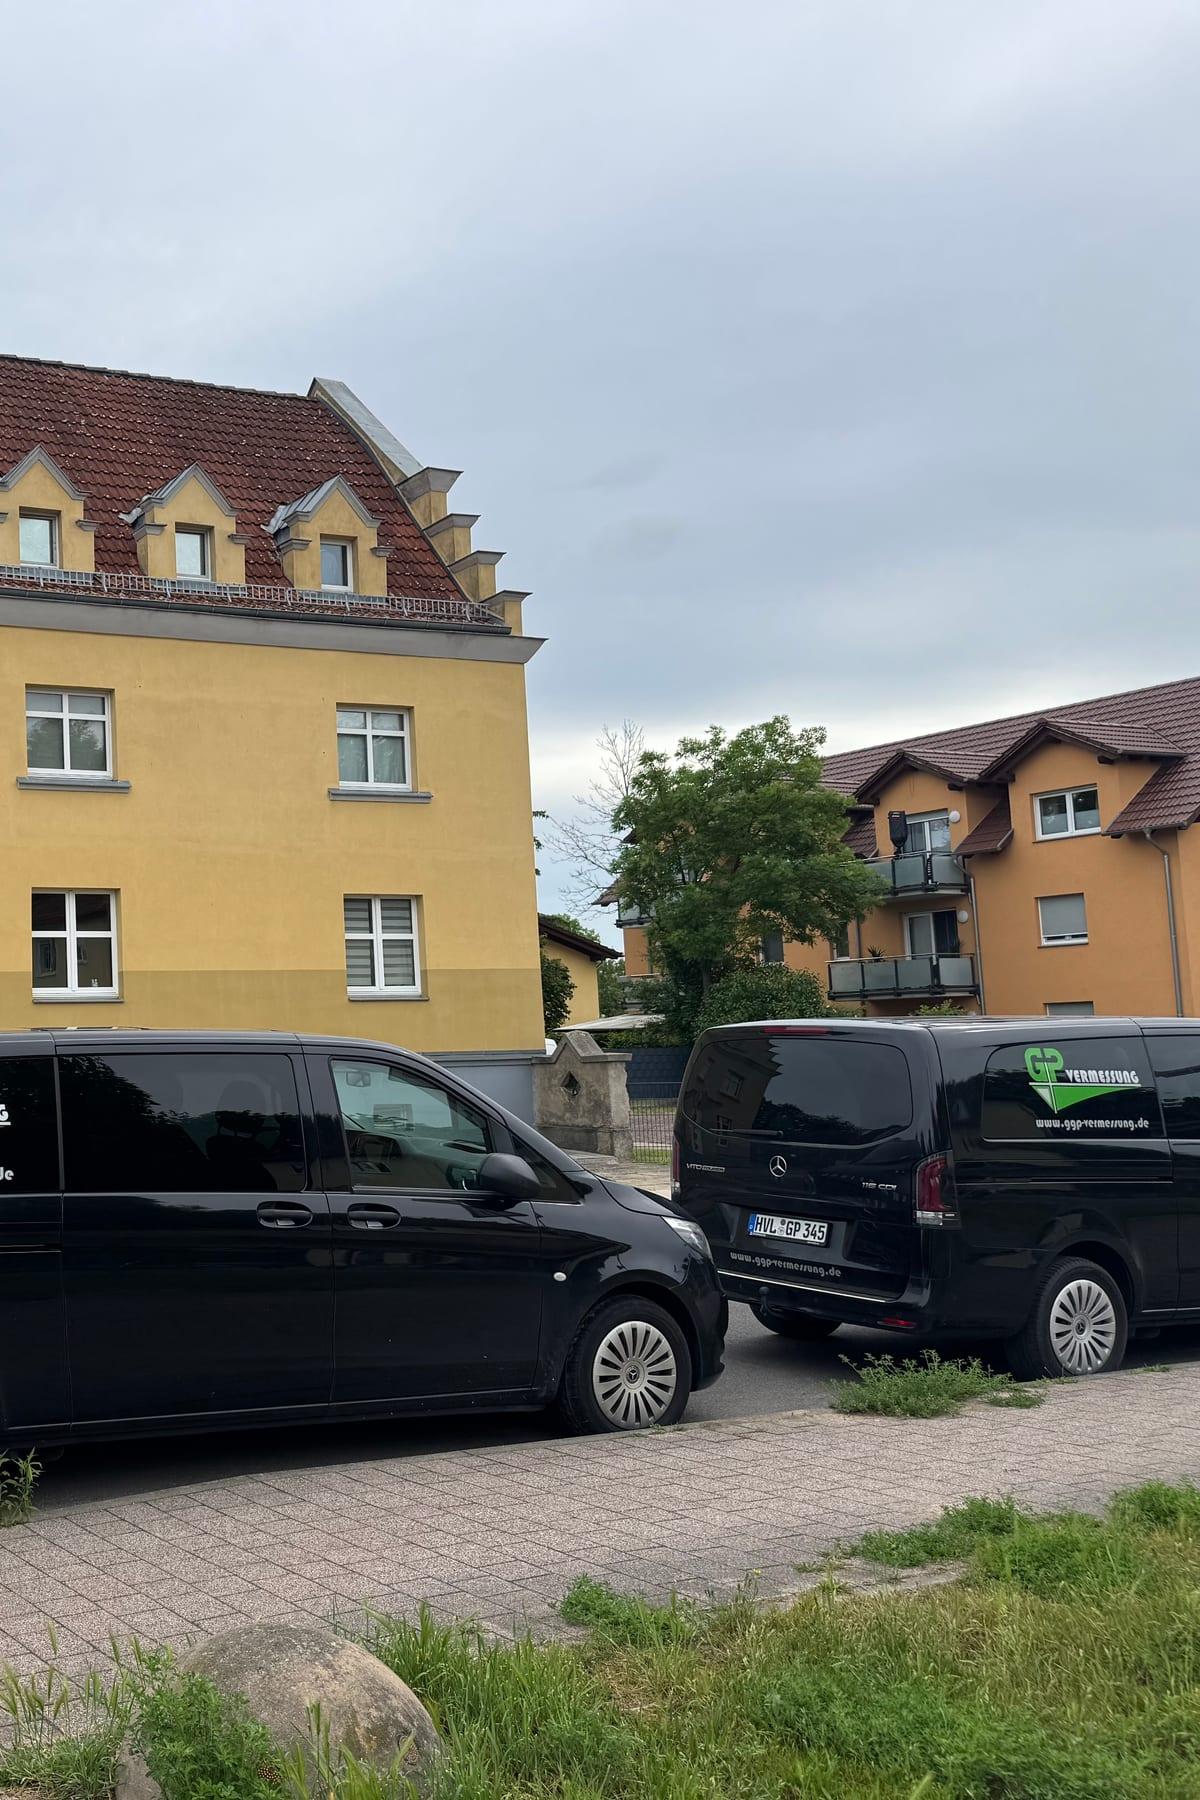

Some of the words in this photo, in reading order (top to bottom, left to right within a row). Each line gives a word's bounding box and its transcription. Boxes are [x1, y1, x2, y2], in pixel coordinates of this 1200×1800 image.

[1024, 1047, 1064, 1082] GP
[1065, 1069, 1140, 1084] VERMESSUNG
[1035, 1117, 1150, 1131] www.ggp-vermessung.de
[754, 1216, 777, 1234] HVL
[785, 1221, 801, 1237] GP
[803, 1223, 826, 1241] 345
[730, 1251, 842, 1277] www.ggp-vermessung.de
